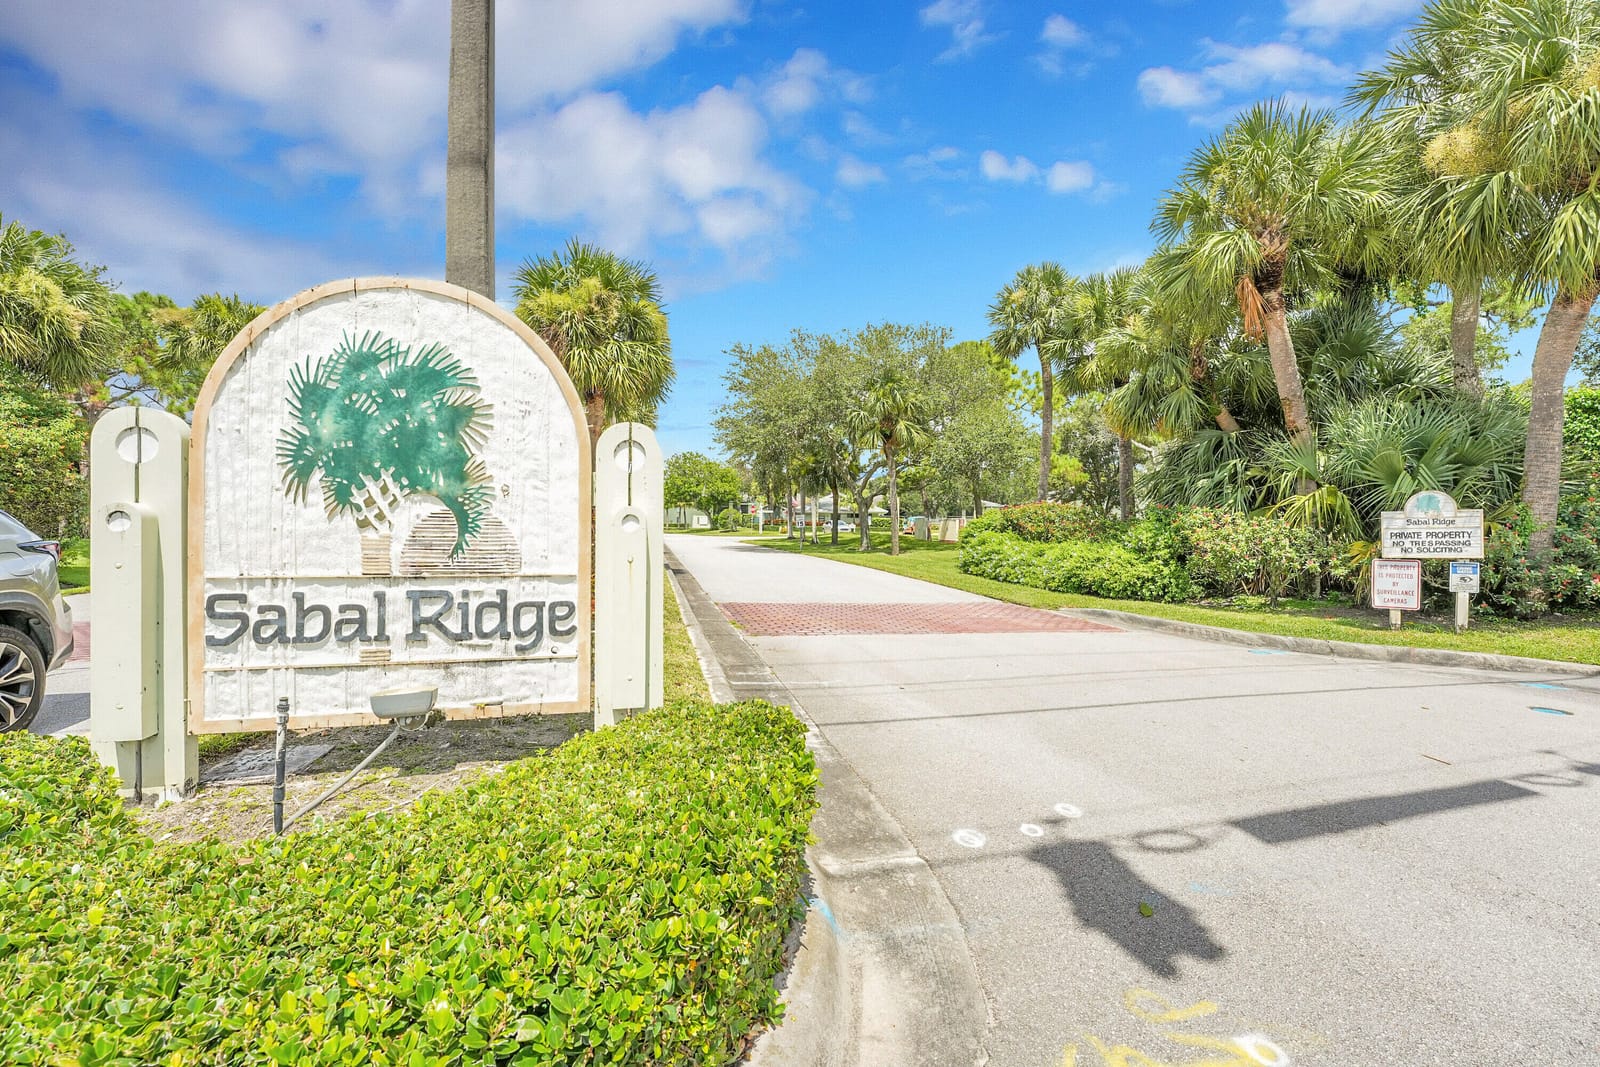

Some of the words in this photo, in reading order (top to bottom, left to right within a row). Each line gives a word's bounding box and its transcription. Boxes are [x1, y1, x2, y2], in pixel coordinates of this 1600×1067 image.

[1406, 518, 1430, 526] Sabal
[1432, 518, 1456, 527] Ridge
[1390, 531, 1422, 540] PRIVATE
[1426, 531, 1472, 539] PROPERTY
[205, 591, 391, 647] Sabal
[405, 589, 578, 652] Ridge
